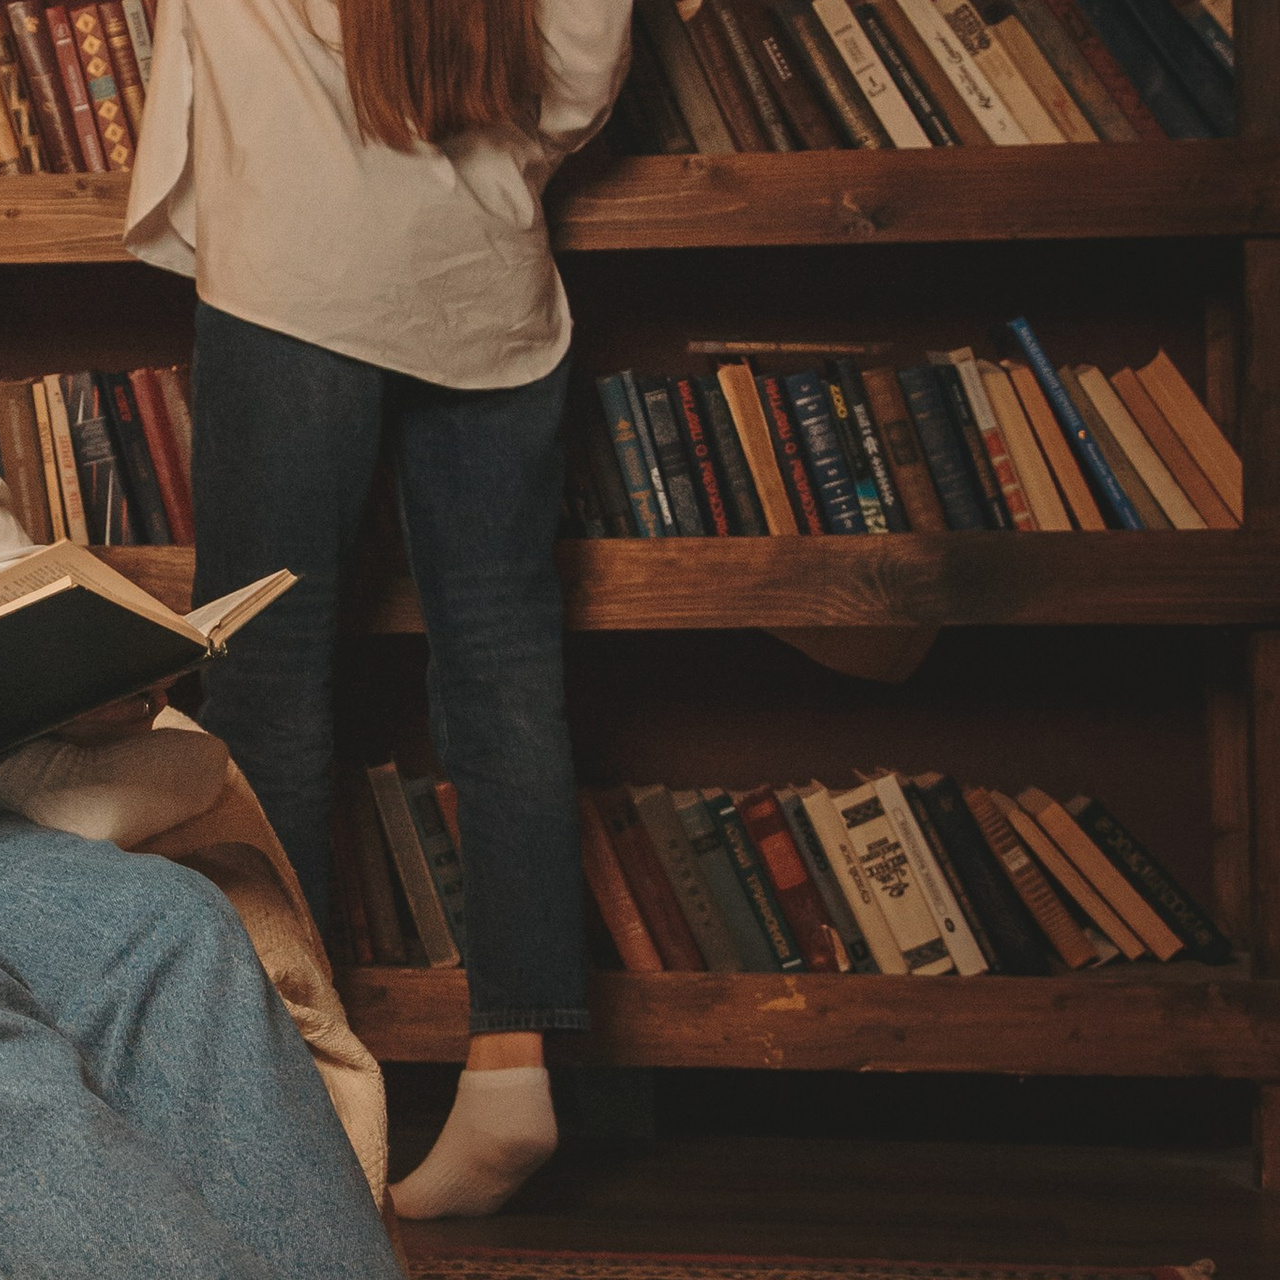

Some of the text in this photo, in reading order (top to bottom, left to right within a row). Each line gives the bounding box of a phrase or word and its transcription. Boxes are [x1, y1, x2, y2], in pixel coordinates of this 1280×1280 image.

[675, 378, 732, 539] РАССКАЗЫ О ПАРТИИ
[762, 376, 823, 536] РАССКАЗЫ О ПАРТИИ
[826, 381, 850, 420] 007
